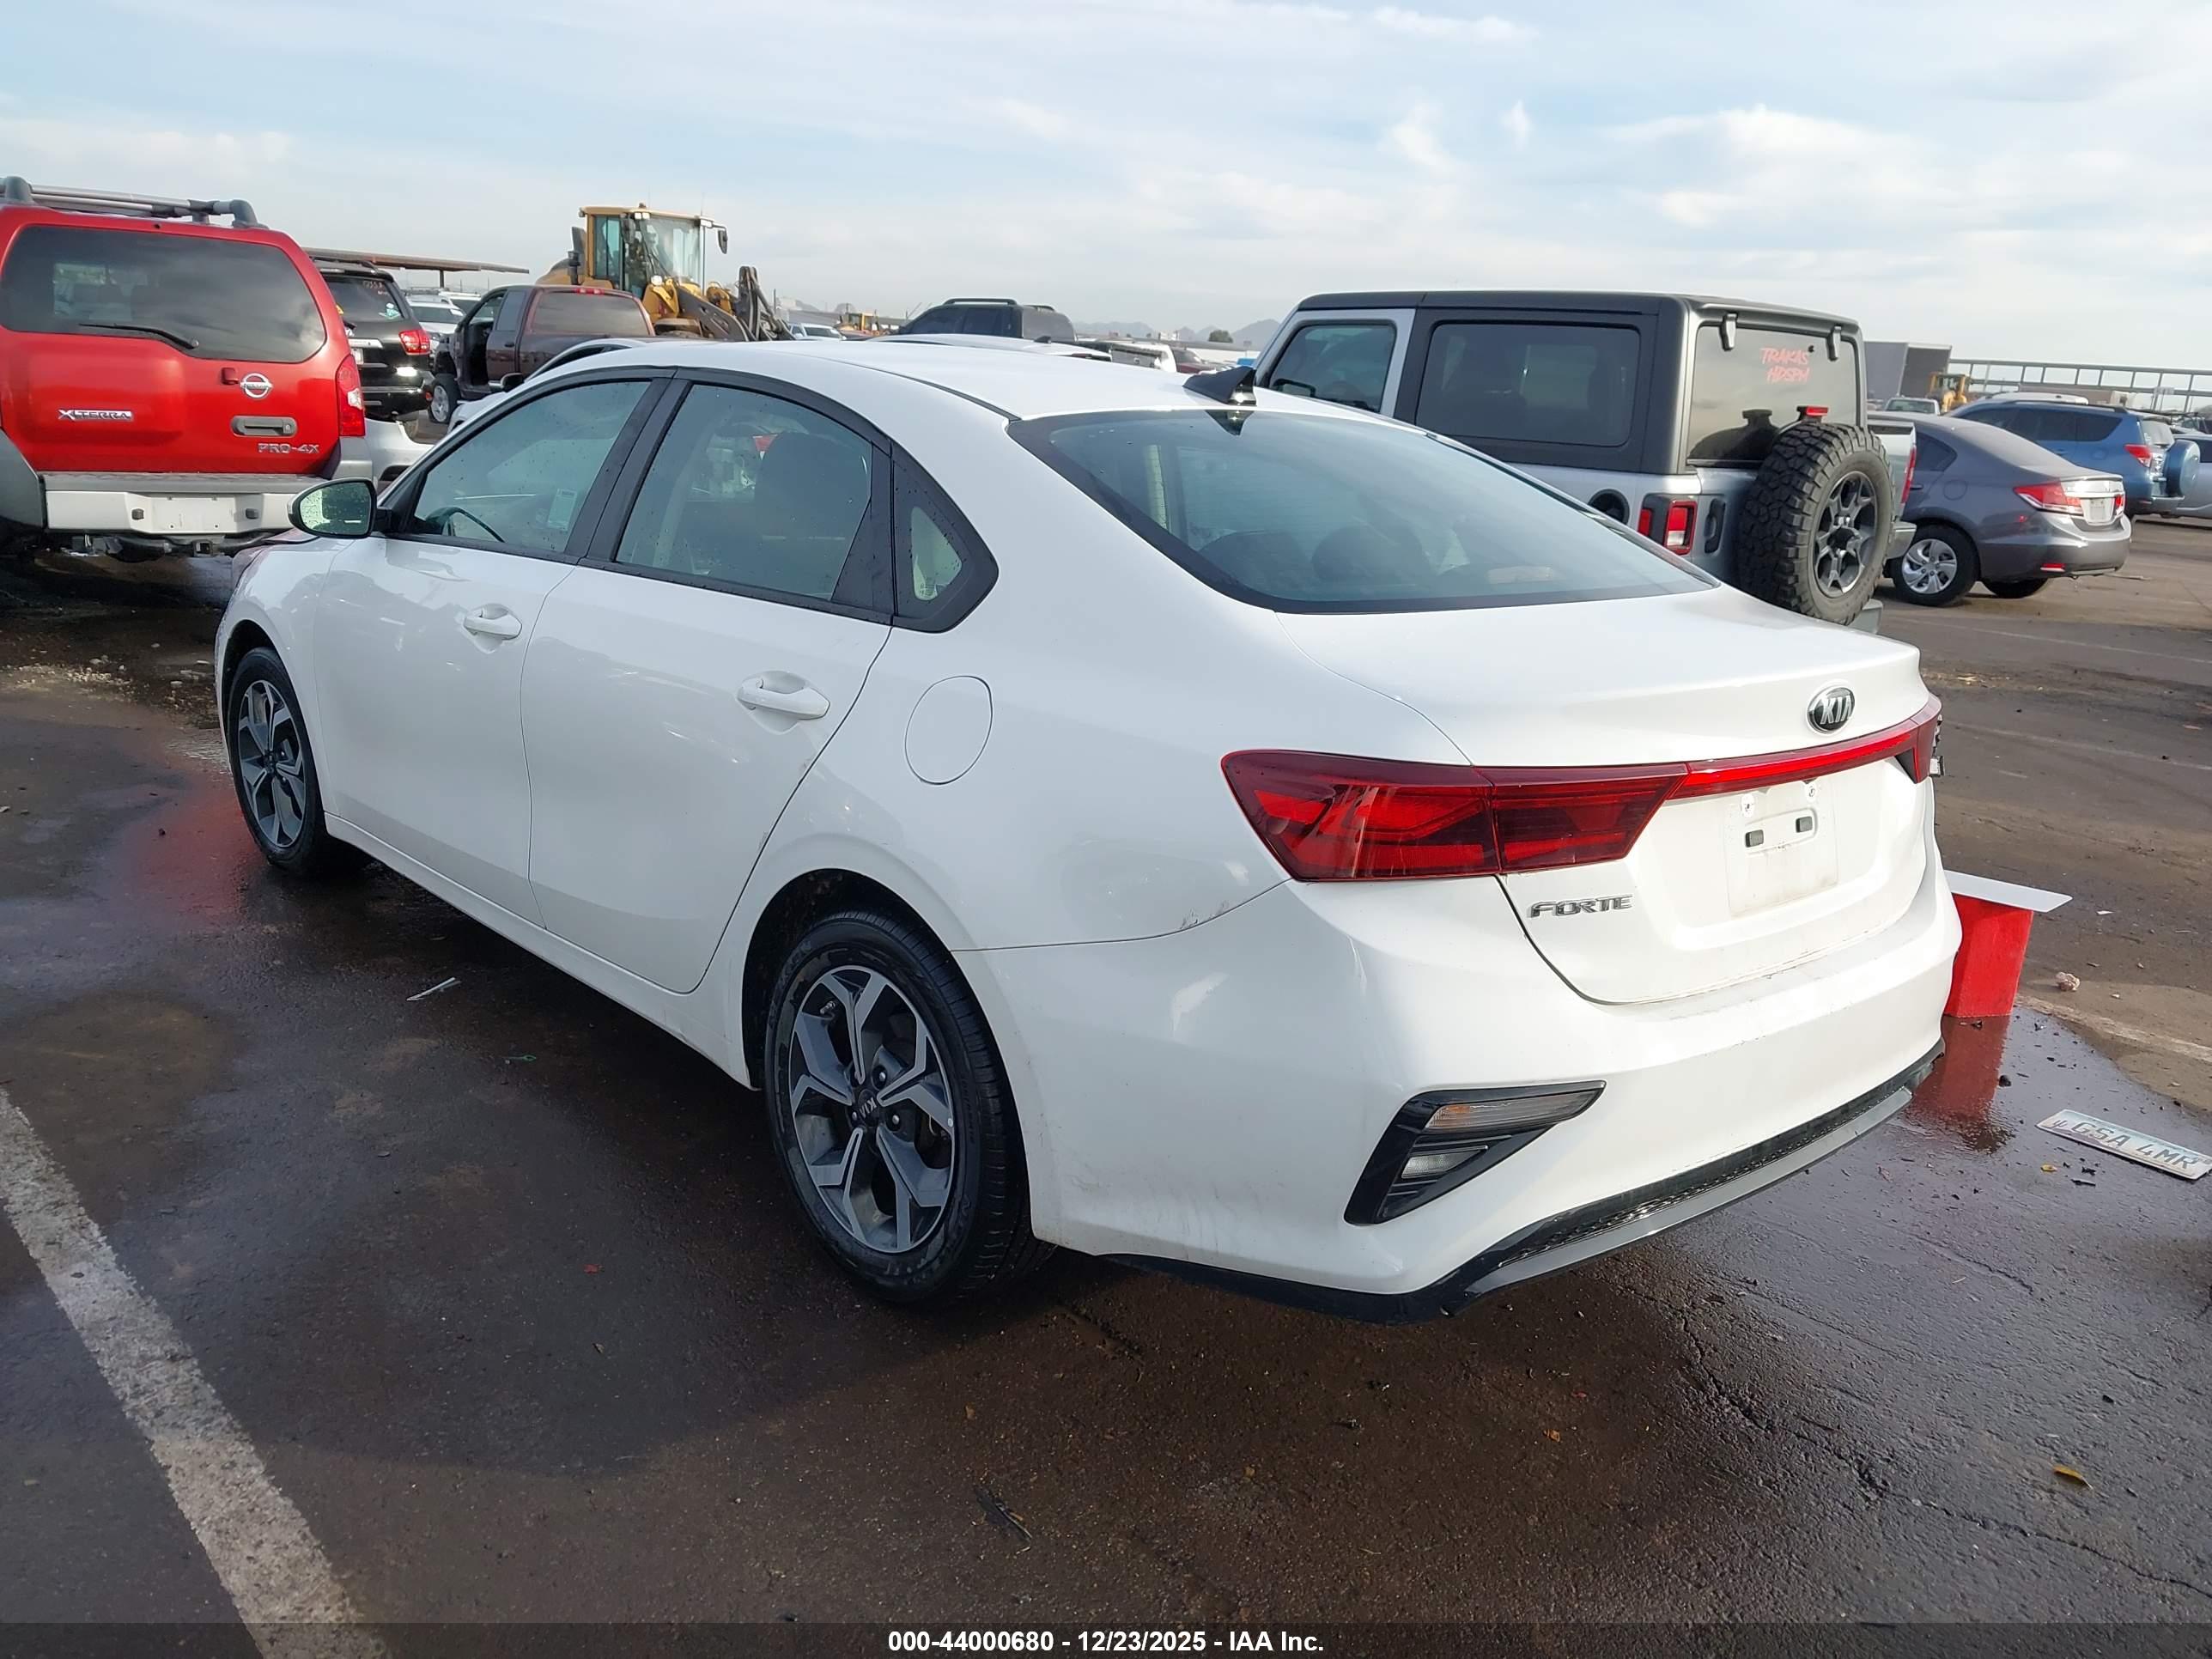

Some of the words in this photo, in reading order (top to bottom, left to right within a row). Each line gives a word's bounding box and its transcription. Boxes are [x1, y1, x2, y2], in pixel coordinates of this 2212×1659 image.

[258, 442, 319, 453] PRO-4X
[1818, 695, 1853, 726] KIA
[1528, 894, 1632, 918] FORTE
[858, 1096, 878, 1119] KIA
[2071, 1121, 2131, 1146] GSA
